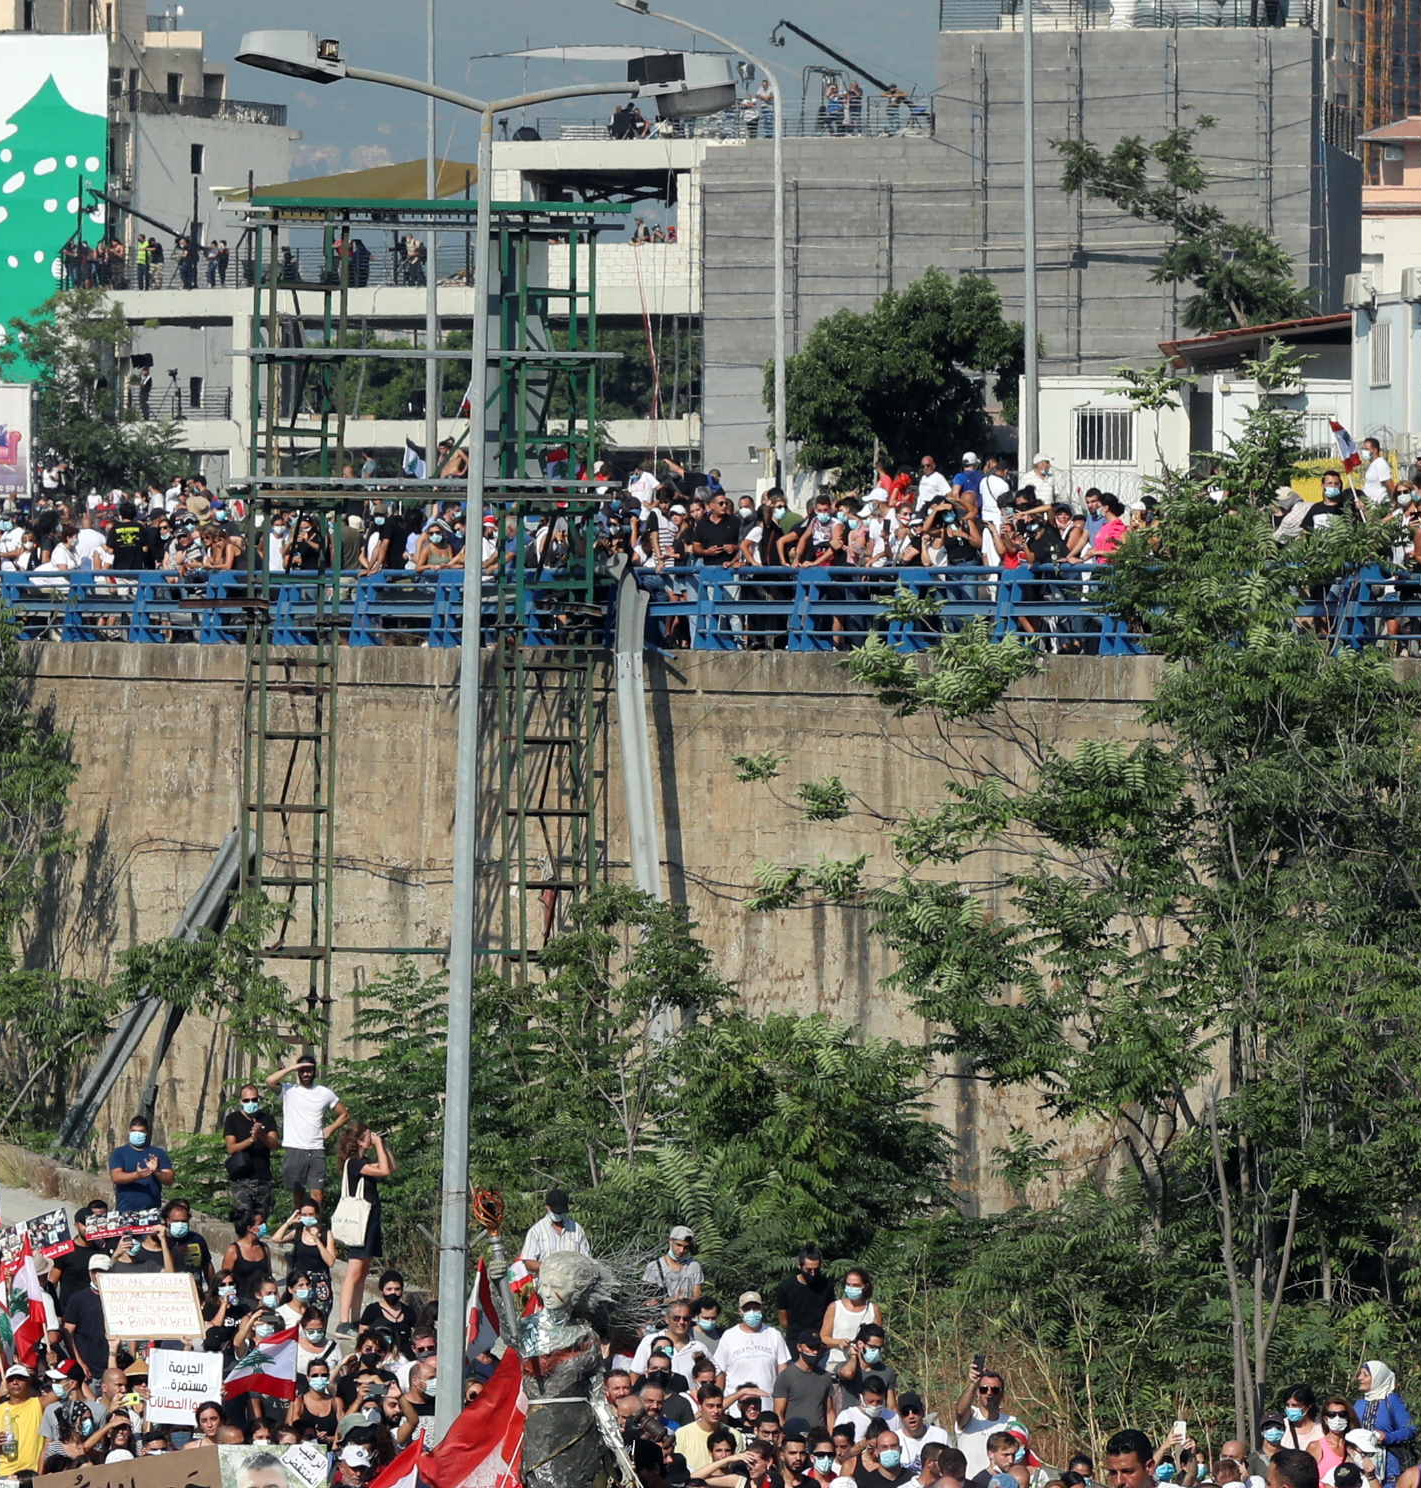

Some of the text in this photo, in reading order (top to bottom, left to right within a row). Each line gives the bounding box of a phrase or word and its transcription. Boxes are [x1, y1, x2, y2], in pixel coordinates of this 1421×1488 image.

[57, 1244, 69, 1253] 214
[105, 1275, 189, 1286] YOU ARE KILLERS
[109, 1291, 148, 1301] YOU ARE
[110, 1304, 125, 1314] YOU
[127, 1304, 143, 1313] ARE
[128, 1315, 196, 1329] BURN HELL
[168, 1362, 204, 1375] الجريمة
